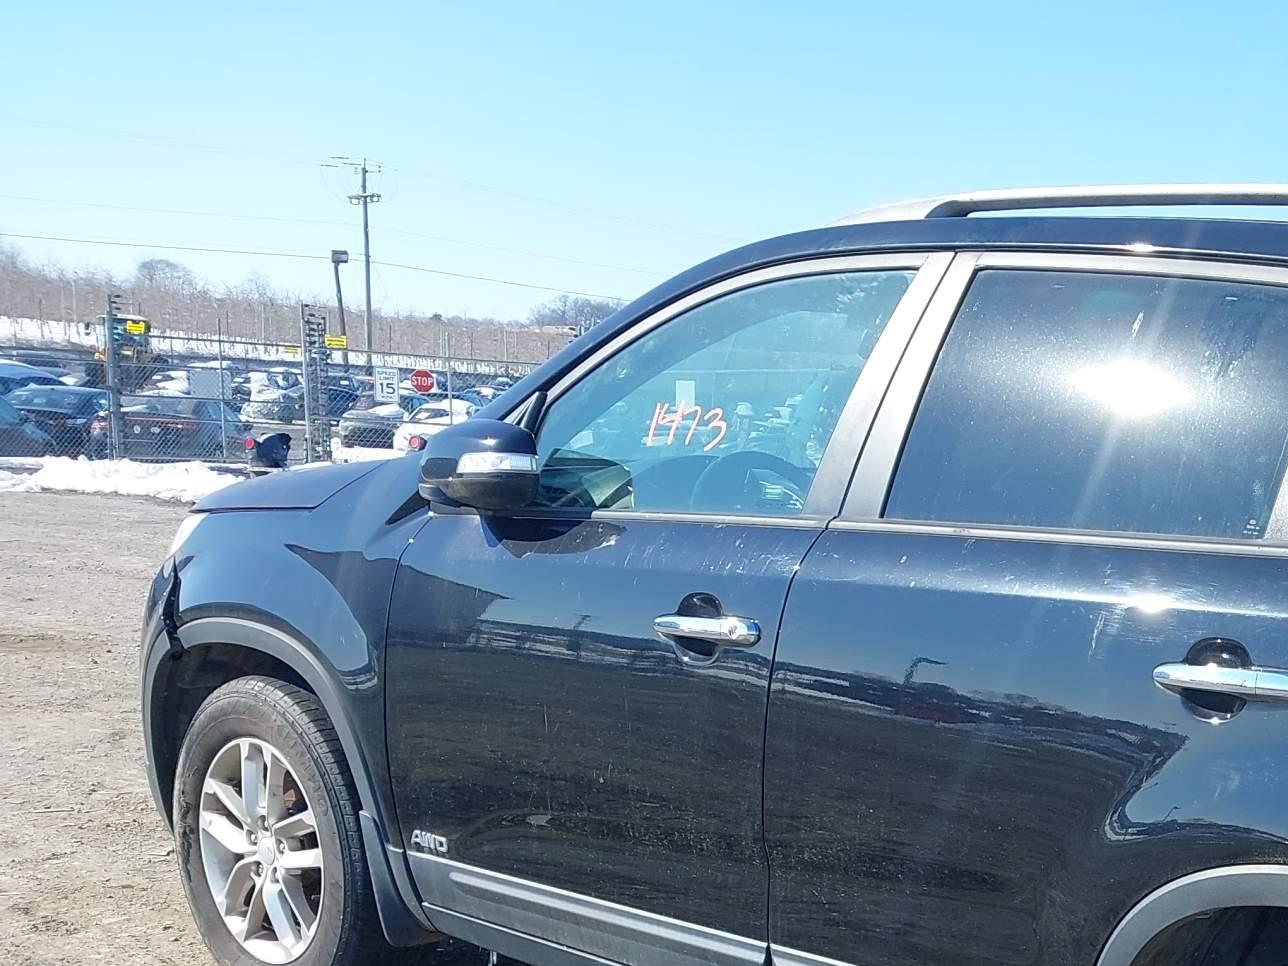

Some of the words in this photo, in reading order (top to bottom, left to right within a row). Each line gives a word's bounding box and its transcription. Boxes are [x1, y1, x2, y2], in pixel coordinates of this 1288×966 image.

[380, 382, 396, 395] 15
[411, 376, 434, 387] STOP
[646, 400, 727, 452] 1473
[411, 829, 448, 853] AWD
